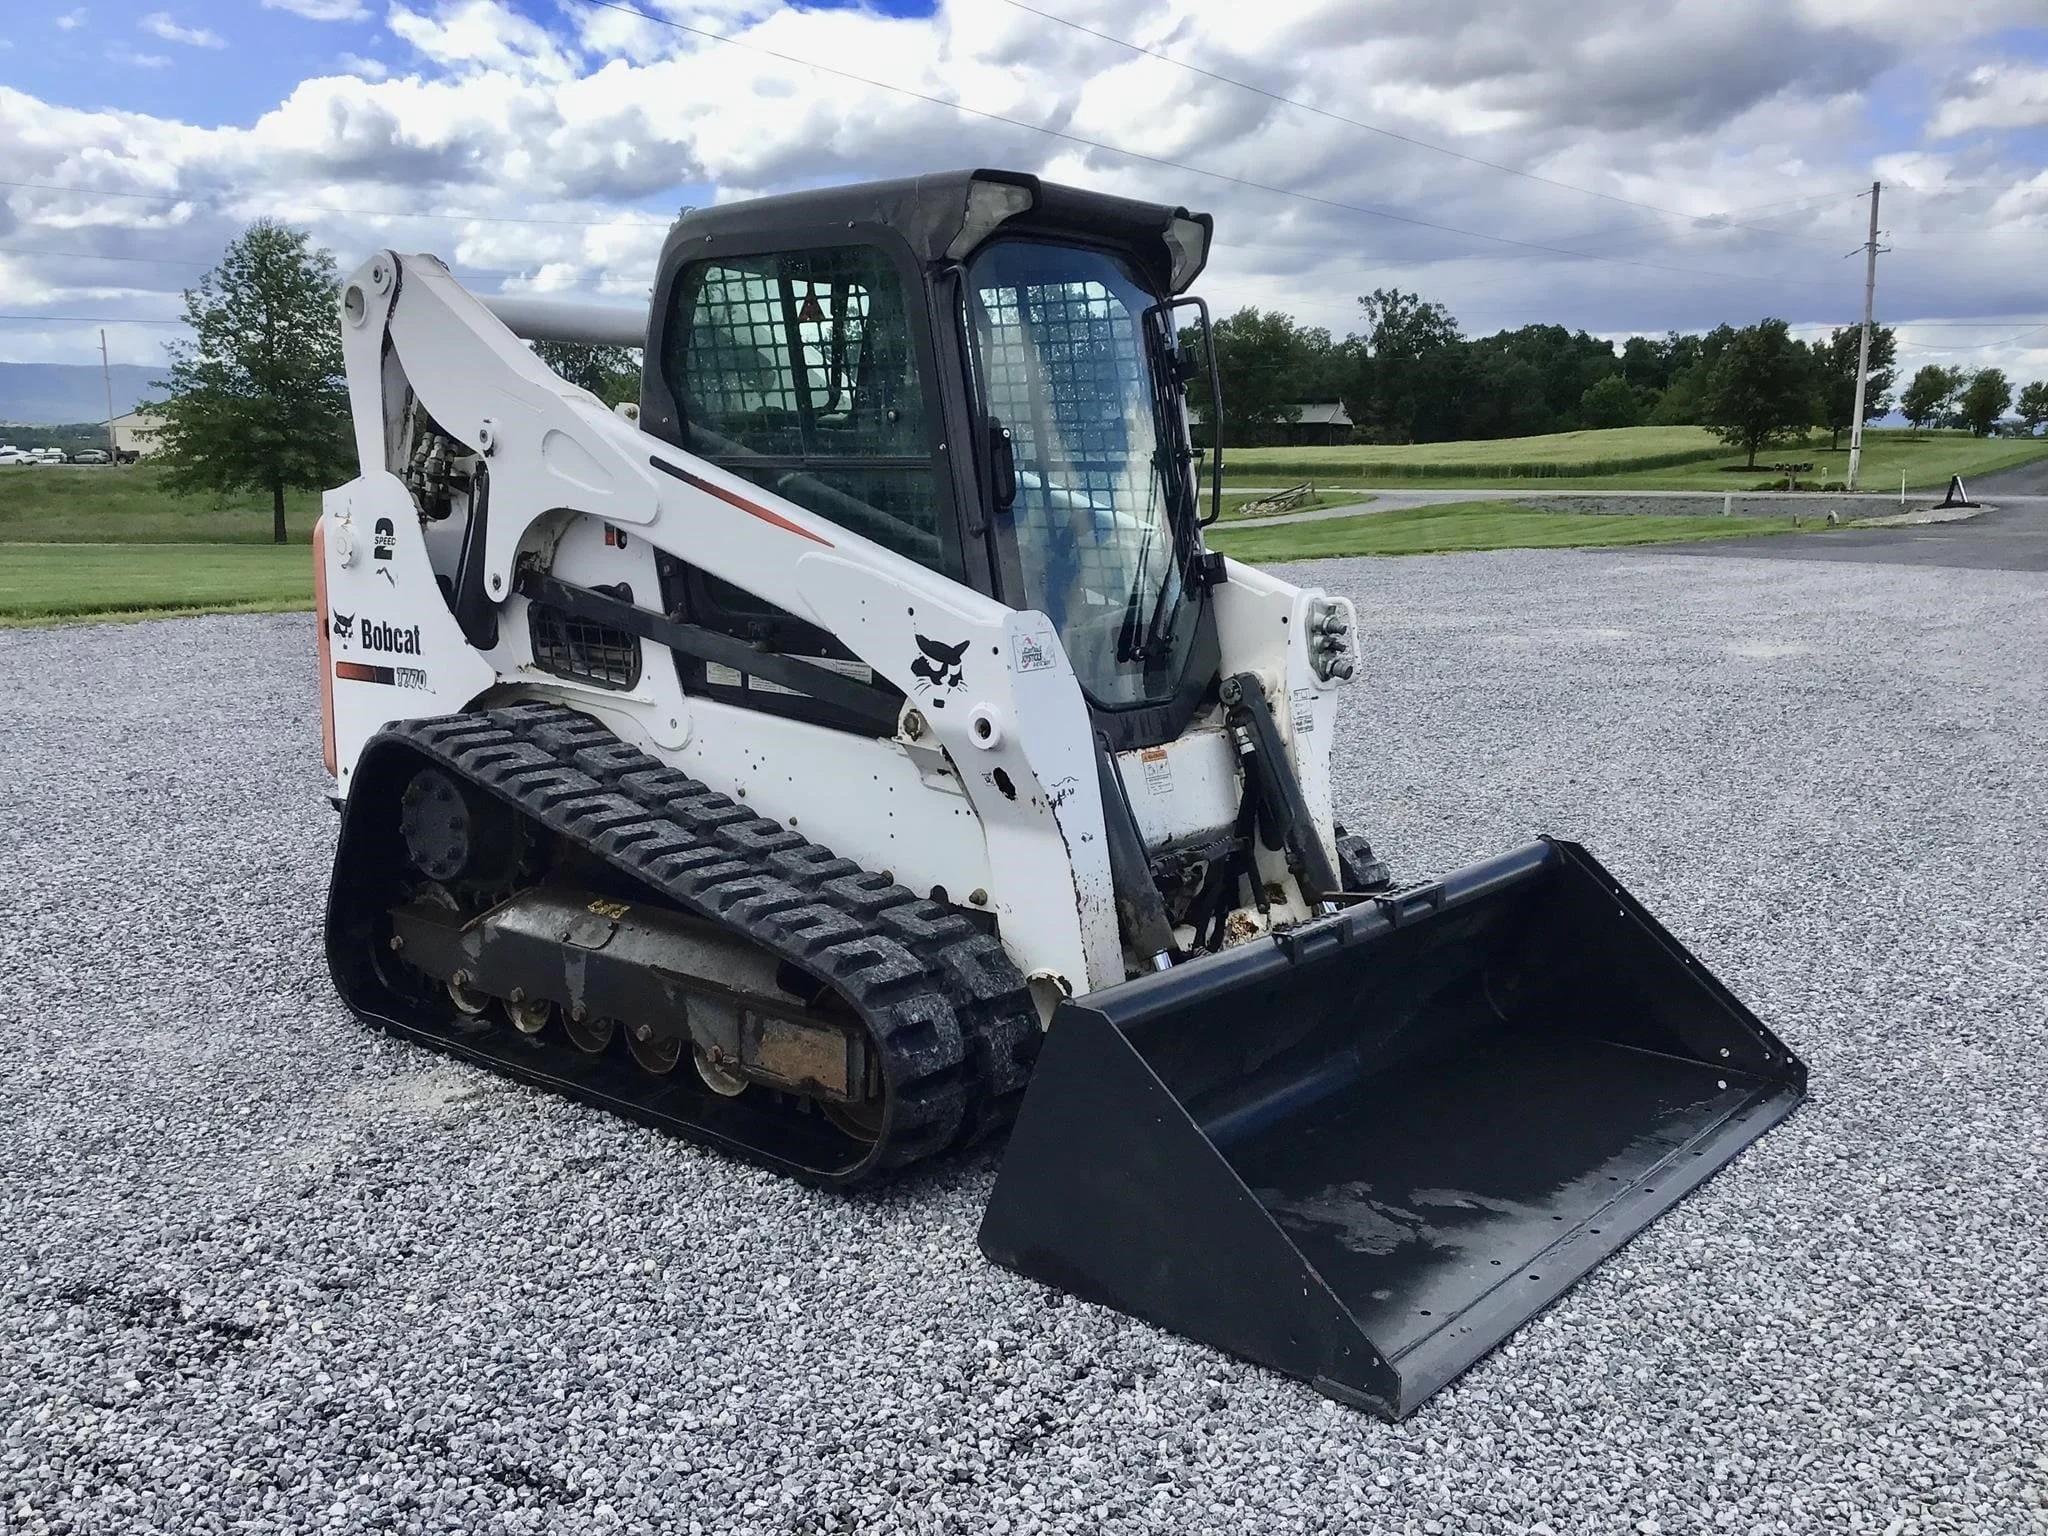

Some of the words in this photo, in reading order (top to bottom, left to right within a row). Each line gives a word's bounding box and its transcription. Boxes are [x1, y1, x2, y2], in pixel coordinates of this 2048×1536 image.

[374, 517, 394, 560] 2
[374, 536, 397, 546] SPEED
[361, 618, 421, 656] Bobcat
[396, 667, 427, 690] T770
